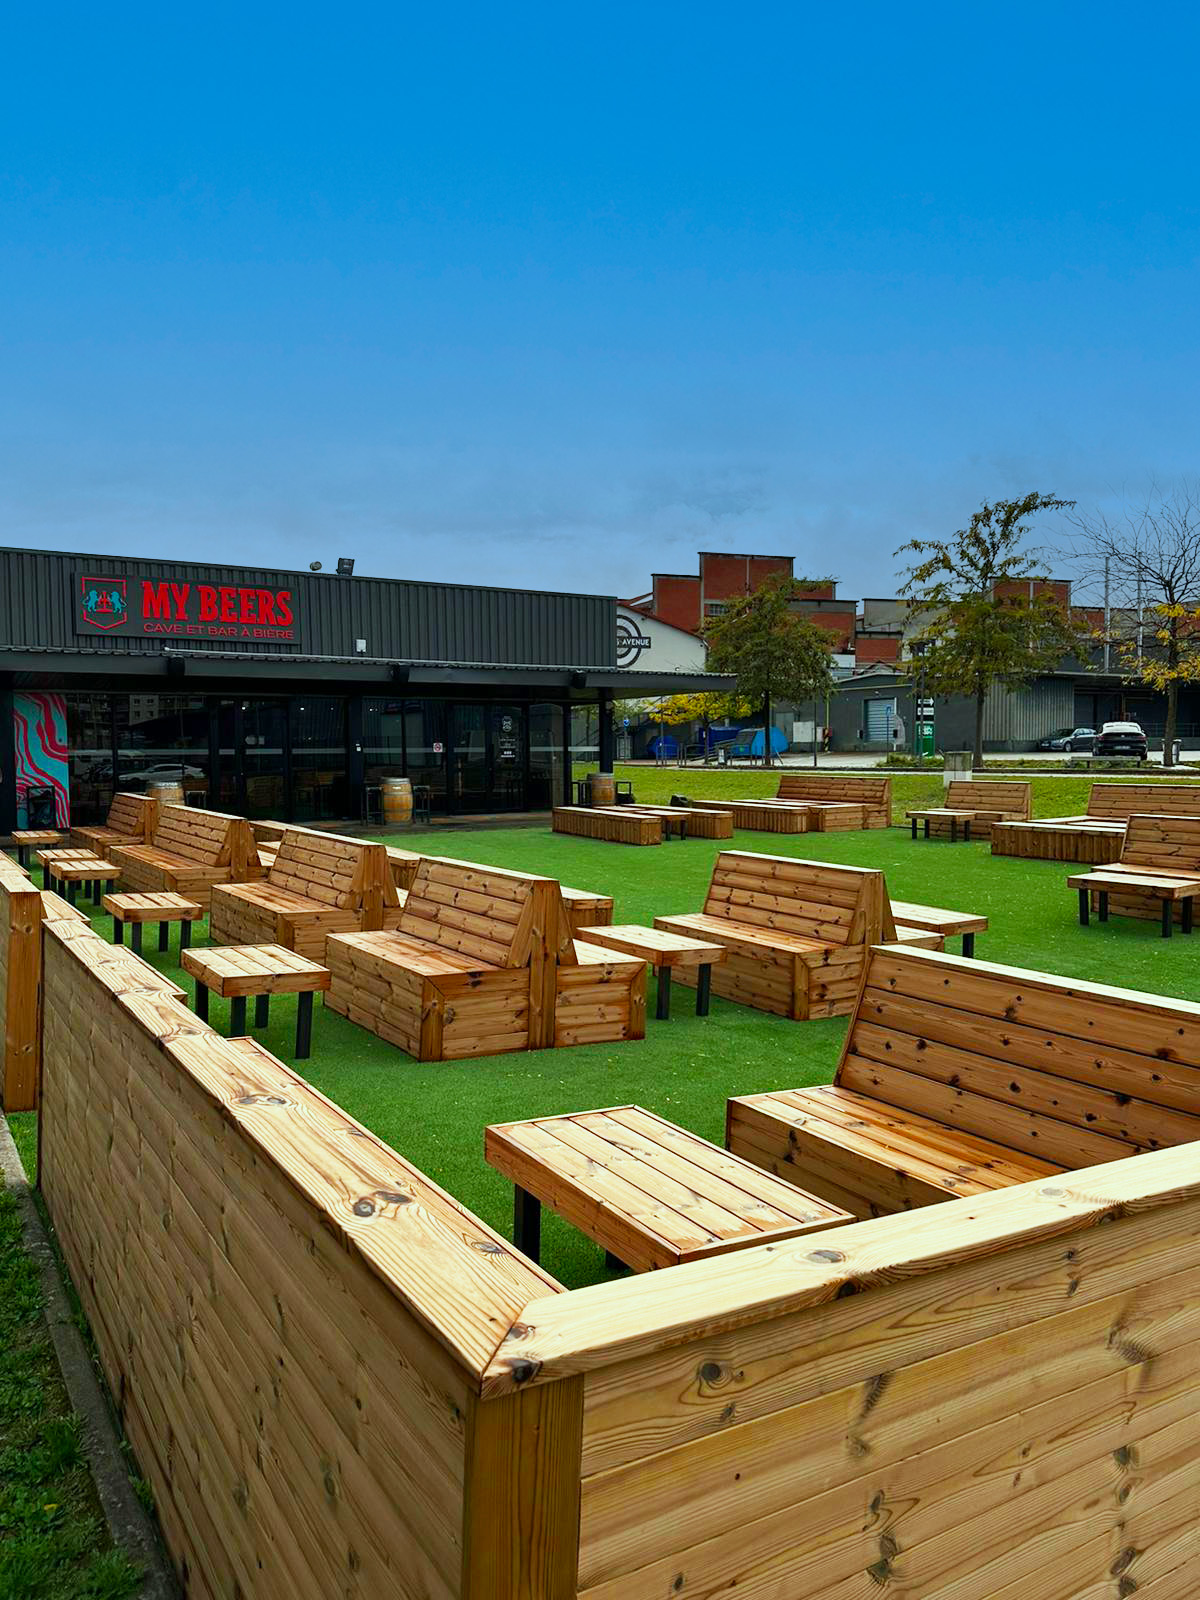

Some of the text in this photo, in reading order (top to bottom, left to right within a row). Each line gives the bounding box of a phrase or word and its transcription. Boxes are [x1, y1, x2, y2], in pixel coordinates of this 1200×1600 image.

[142, 581, 293, 627] MY BEERS
[143, 623, 182, 633] CAVE
[186, 625, 205, 634] ET
[207, 626, 238, 637] BAR
[622, 638, 650, 646] AVENUE
